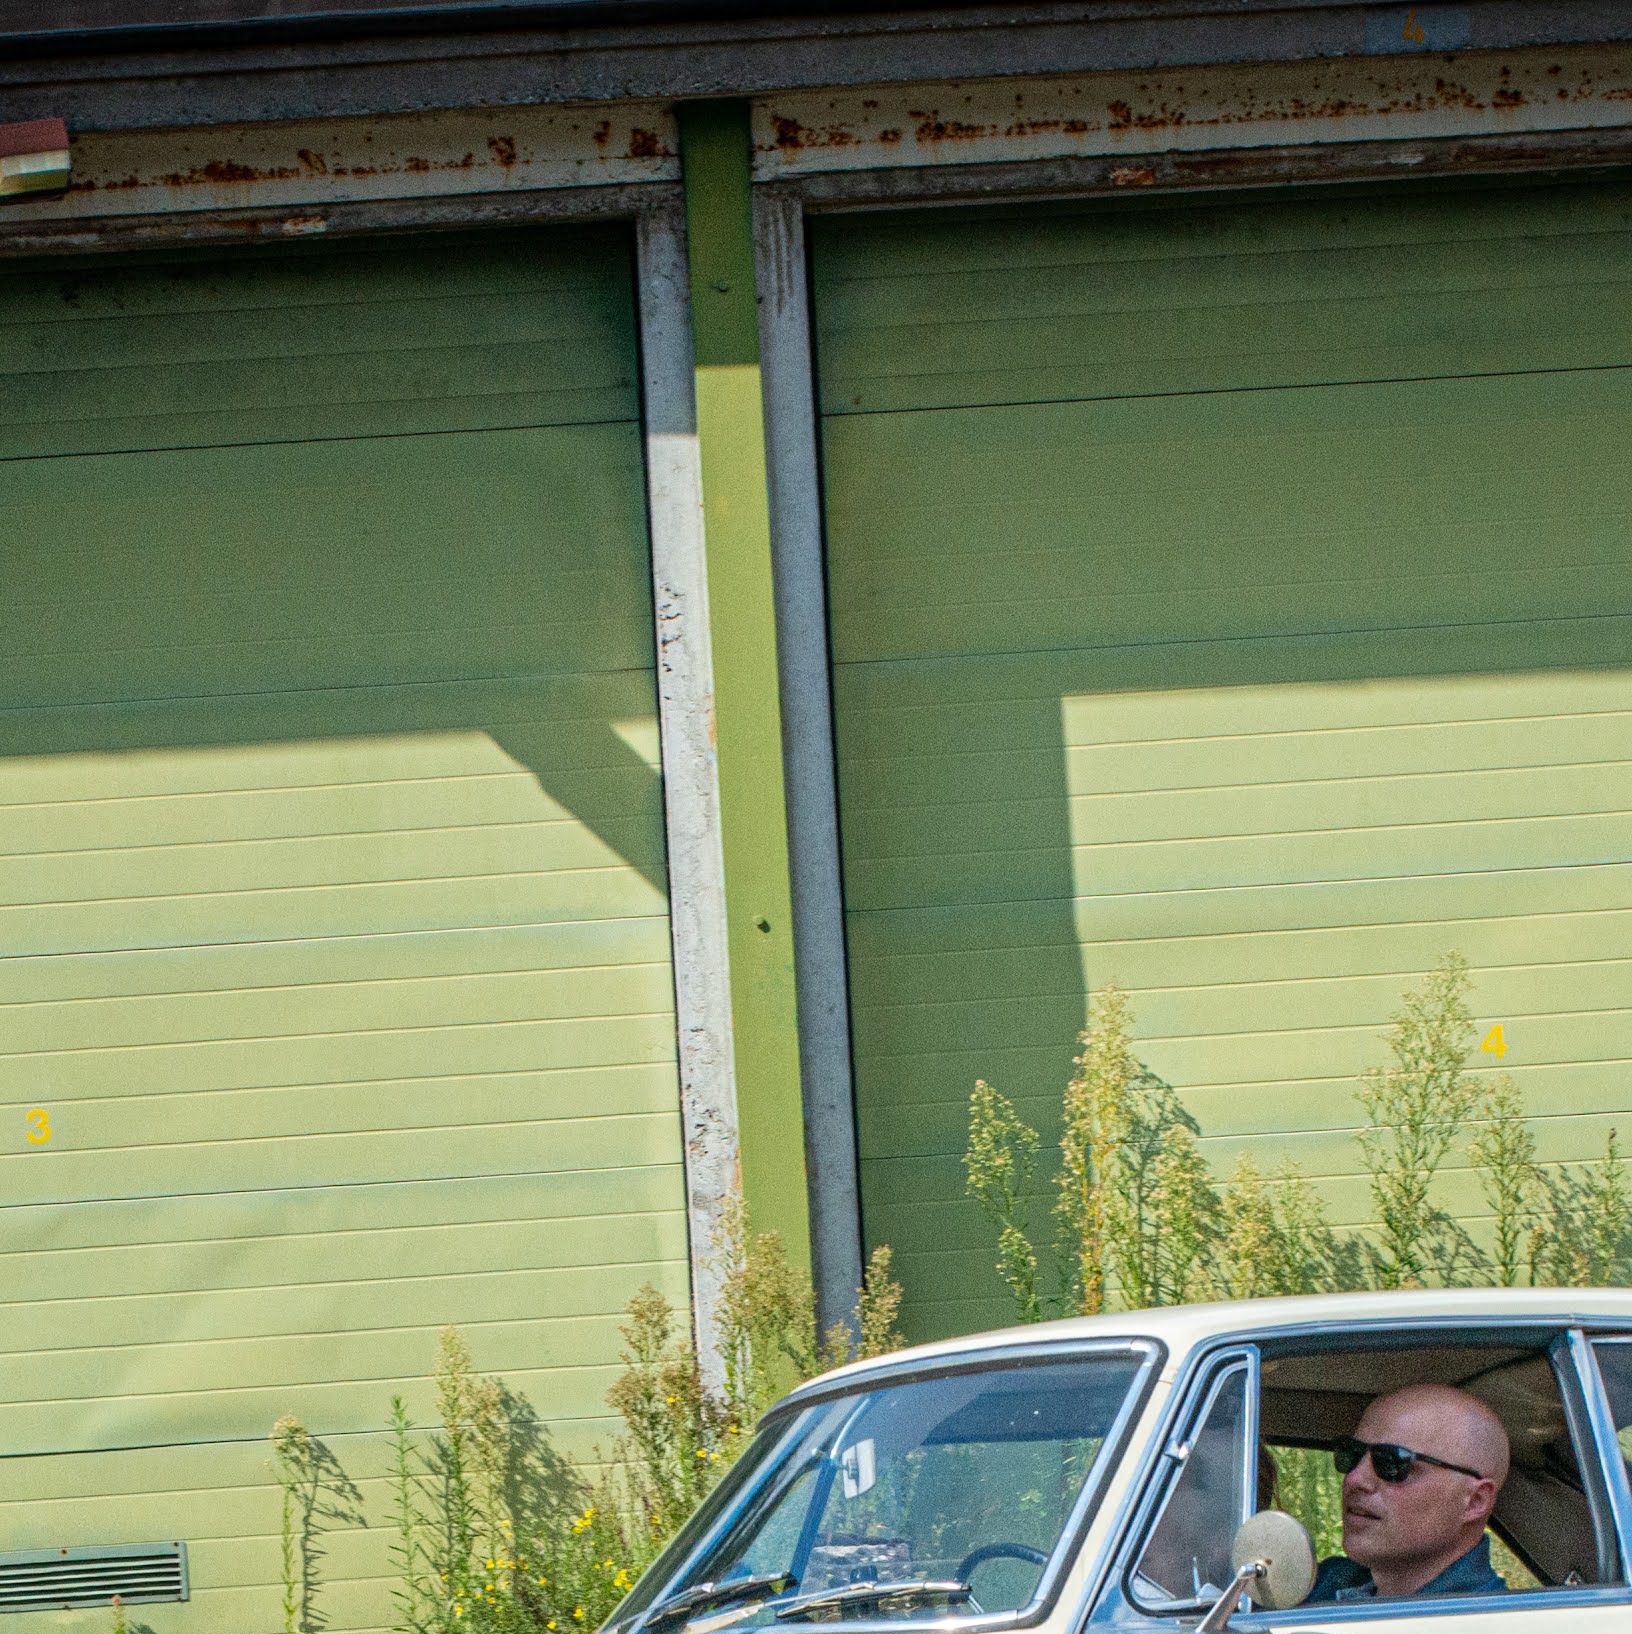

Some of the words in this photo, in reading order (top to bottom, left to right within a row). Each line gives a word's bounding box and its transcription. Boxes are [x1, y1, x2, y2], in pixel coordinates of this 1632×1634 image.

[1401, 6, 1425, 45] 4
[1481, 1024, 1508, 1059] 4
[25, 1109, 52, 1145] 3
